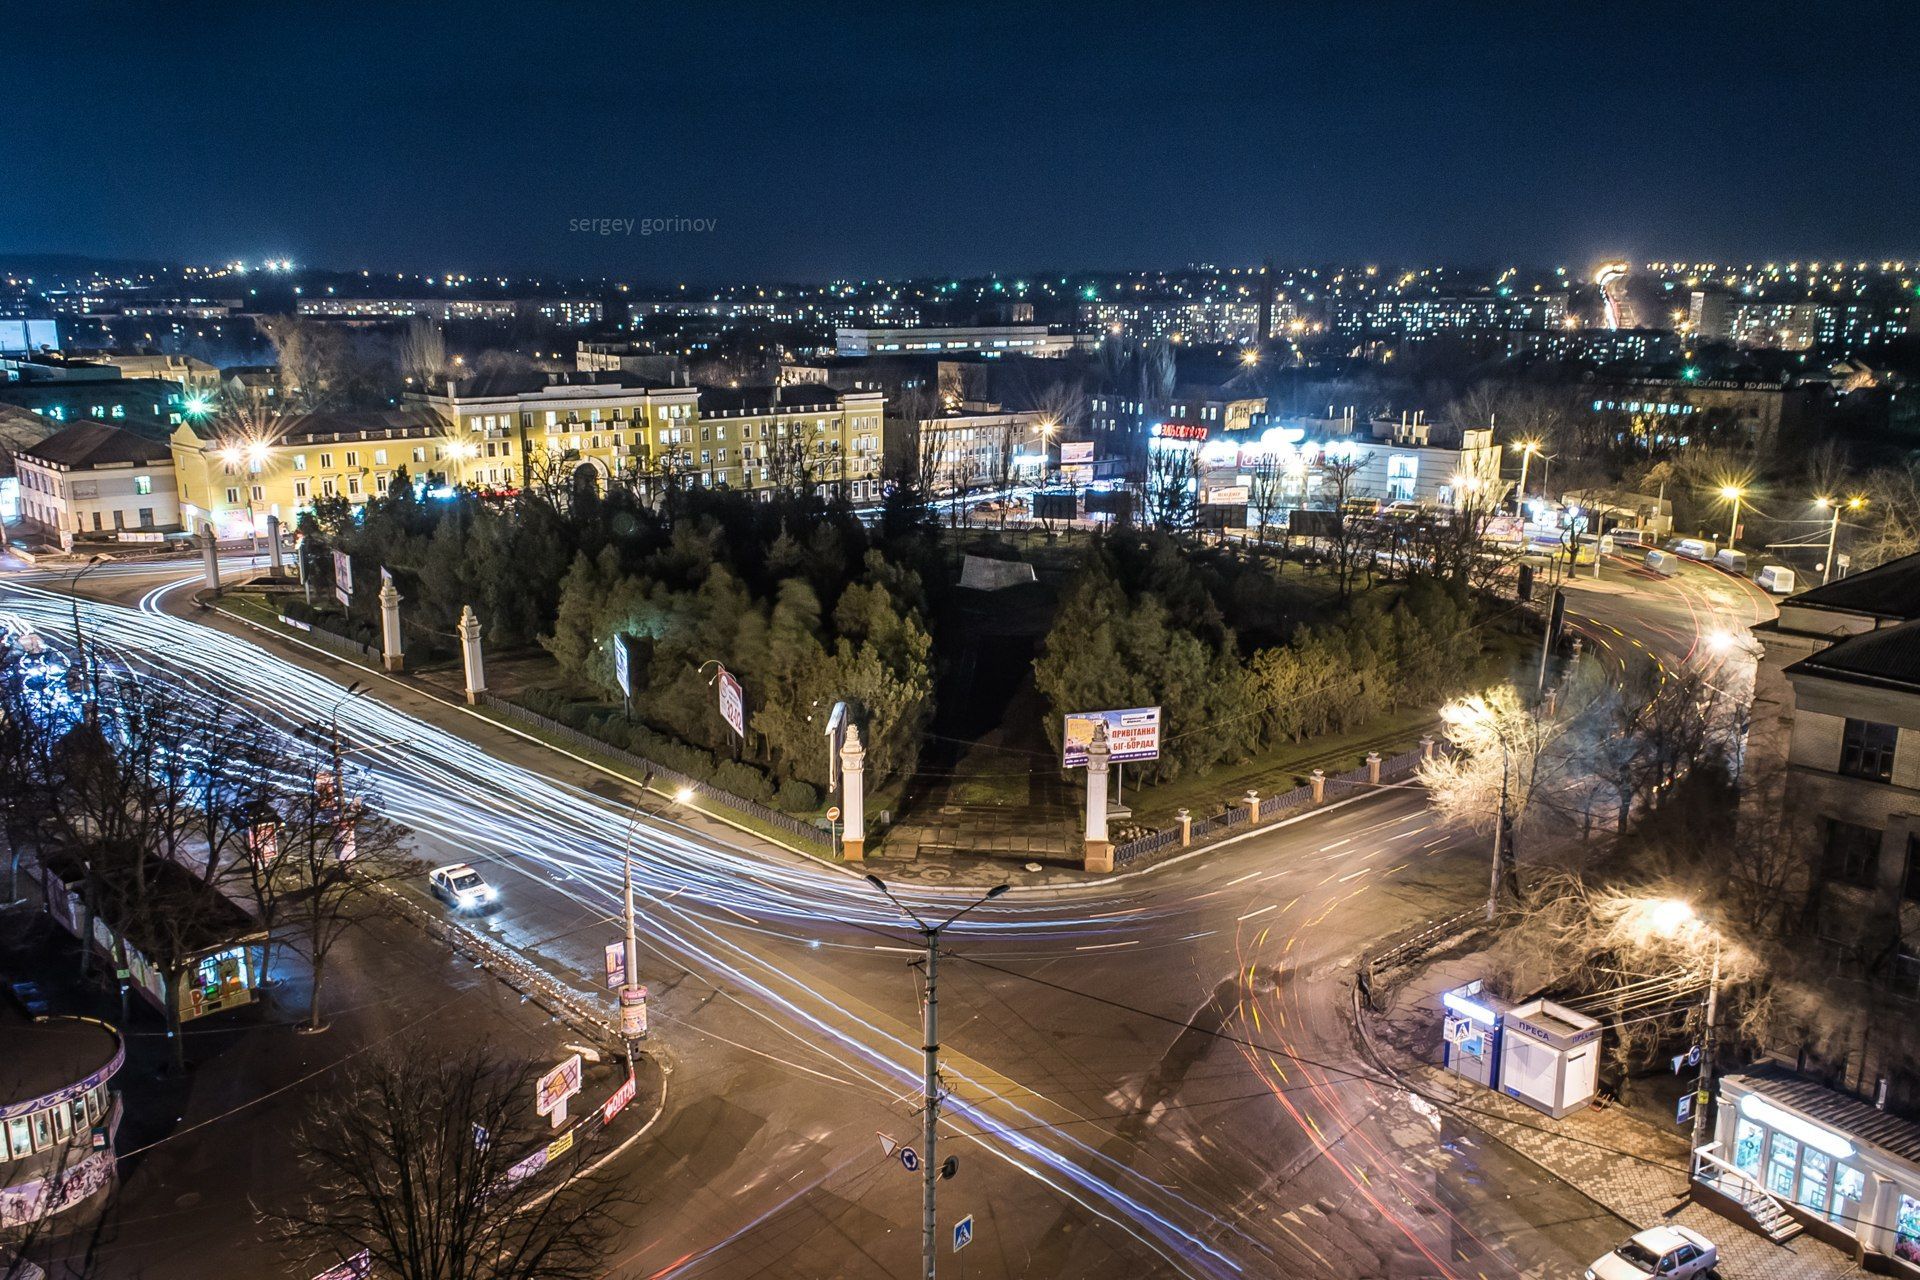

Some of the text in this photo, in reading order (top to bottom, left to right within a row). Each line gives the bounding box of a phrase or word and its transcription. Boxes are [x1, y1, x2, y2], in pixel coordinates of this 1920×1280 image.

[1111, 727, 1156, 739] ПРИВІТАННЯ
[1113, 740, 1155, 751] БІГ-БОРДАХ
[1518, 1021, 1550, 1041] ПРЕСА
